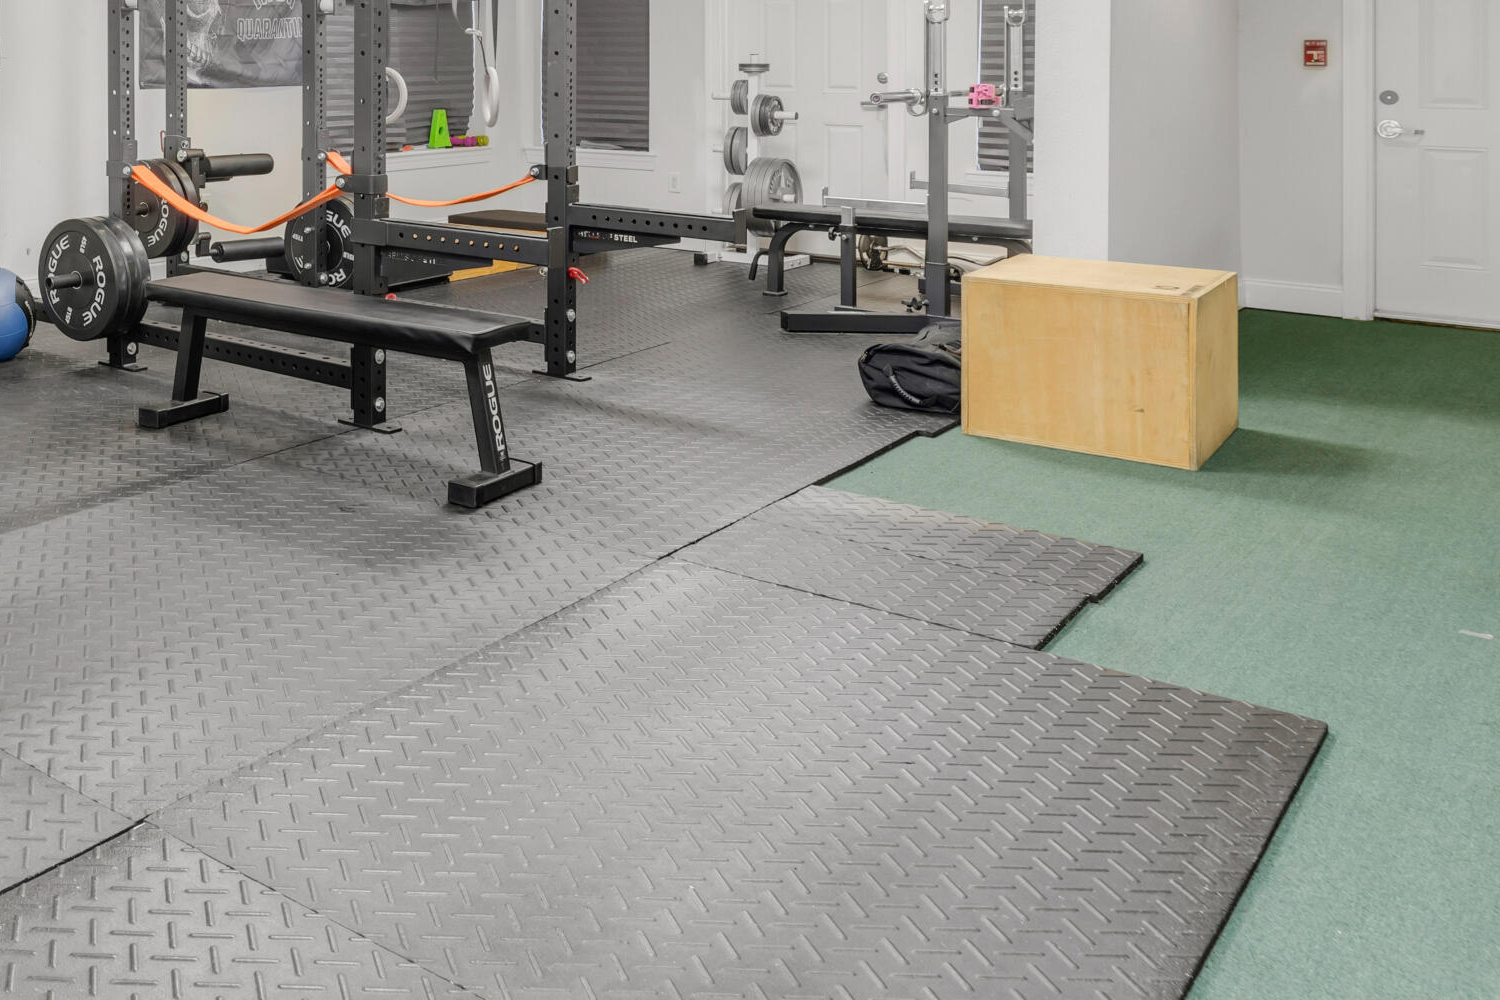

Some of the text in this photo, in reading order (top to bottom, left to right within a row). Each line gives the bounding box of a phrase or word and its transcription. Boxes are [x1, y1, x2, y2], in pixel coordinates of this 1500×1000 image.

[613, 233, 638, 243] STEEL
[82, 254, 106, 327] ROGUE
[482, 363, 506, 452] ROGUE
